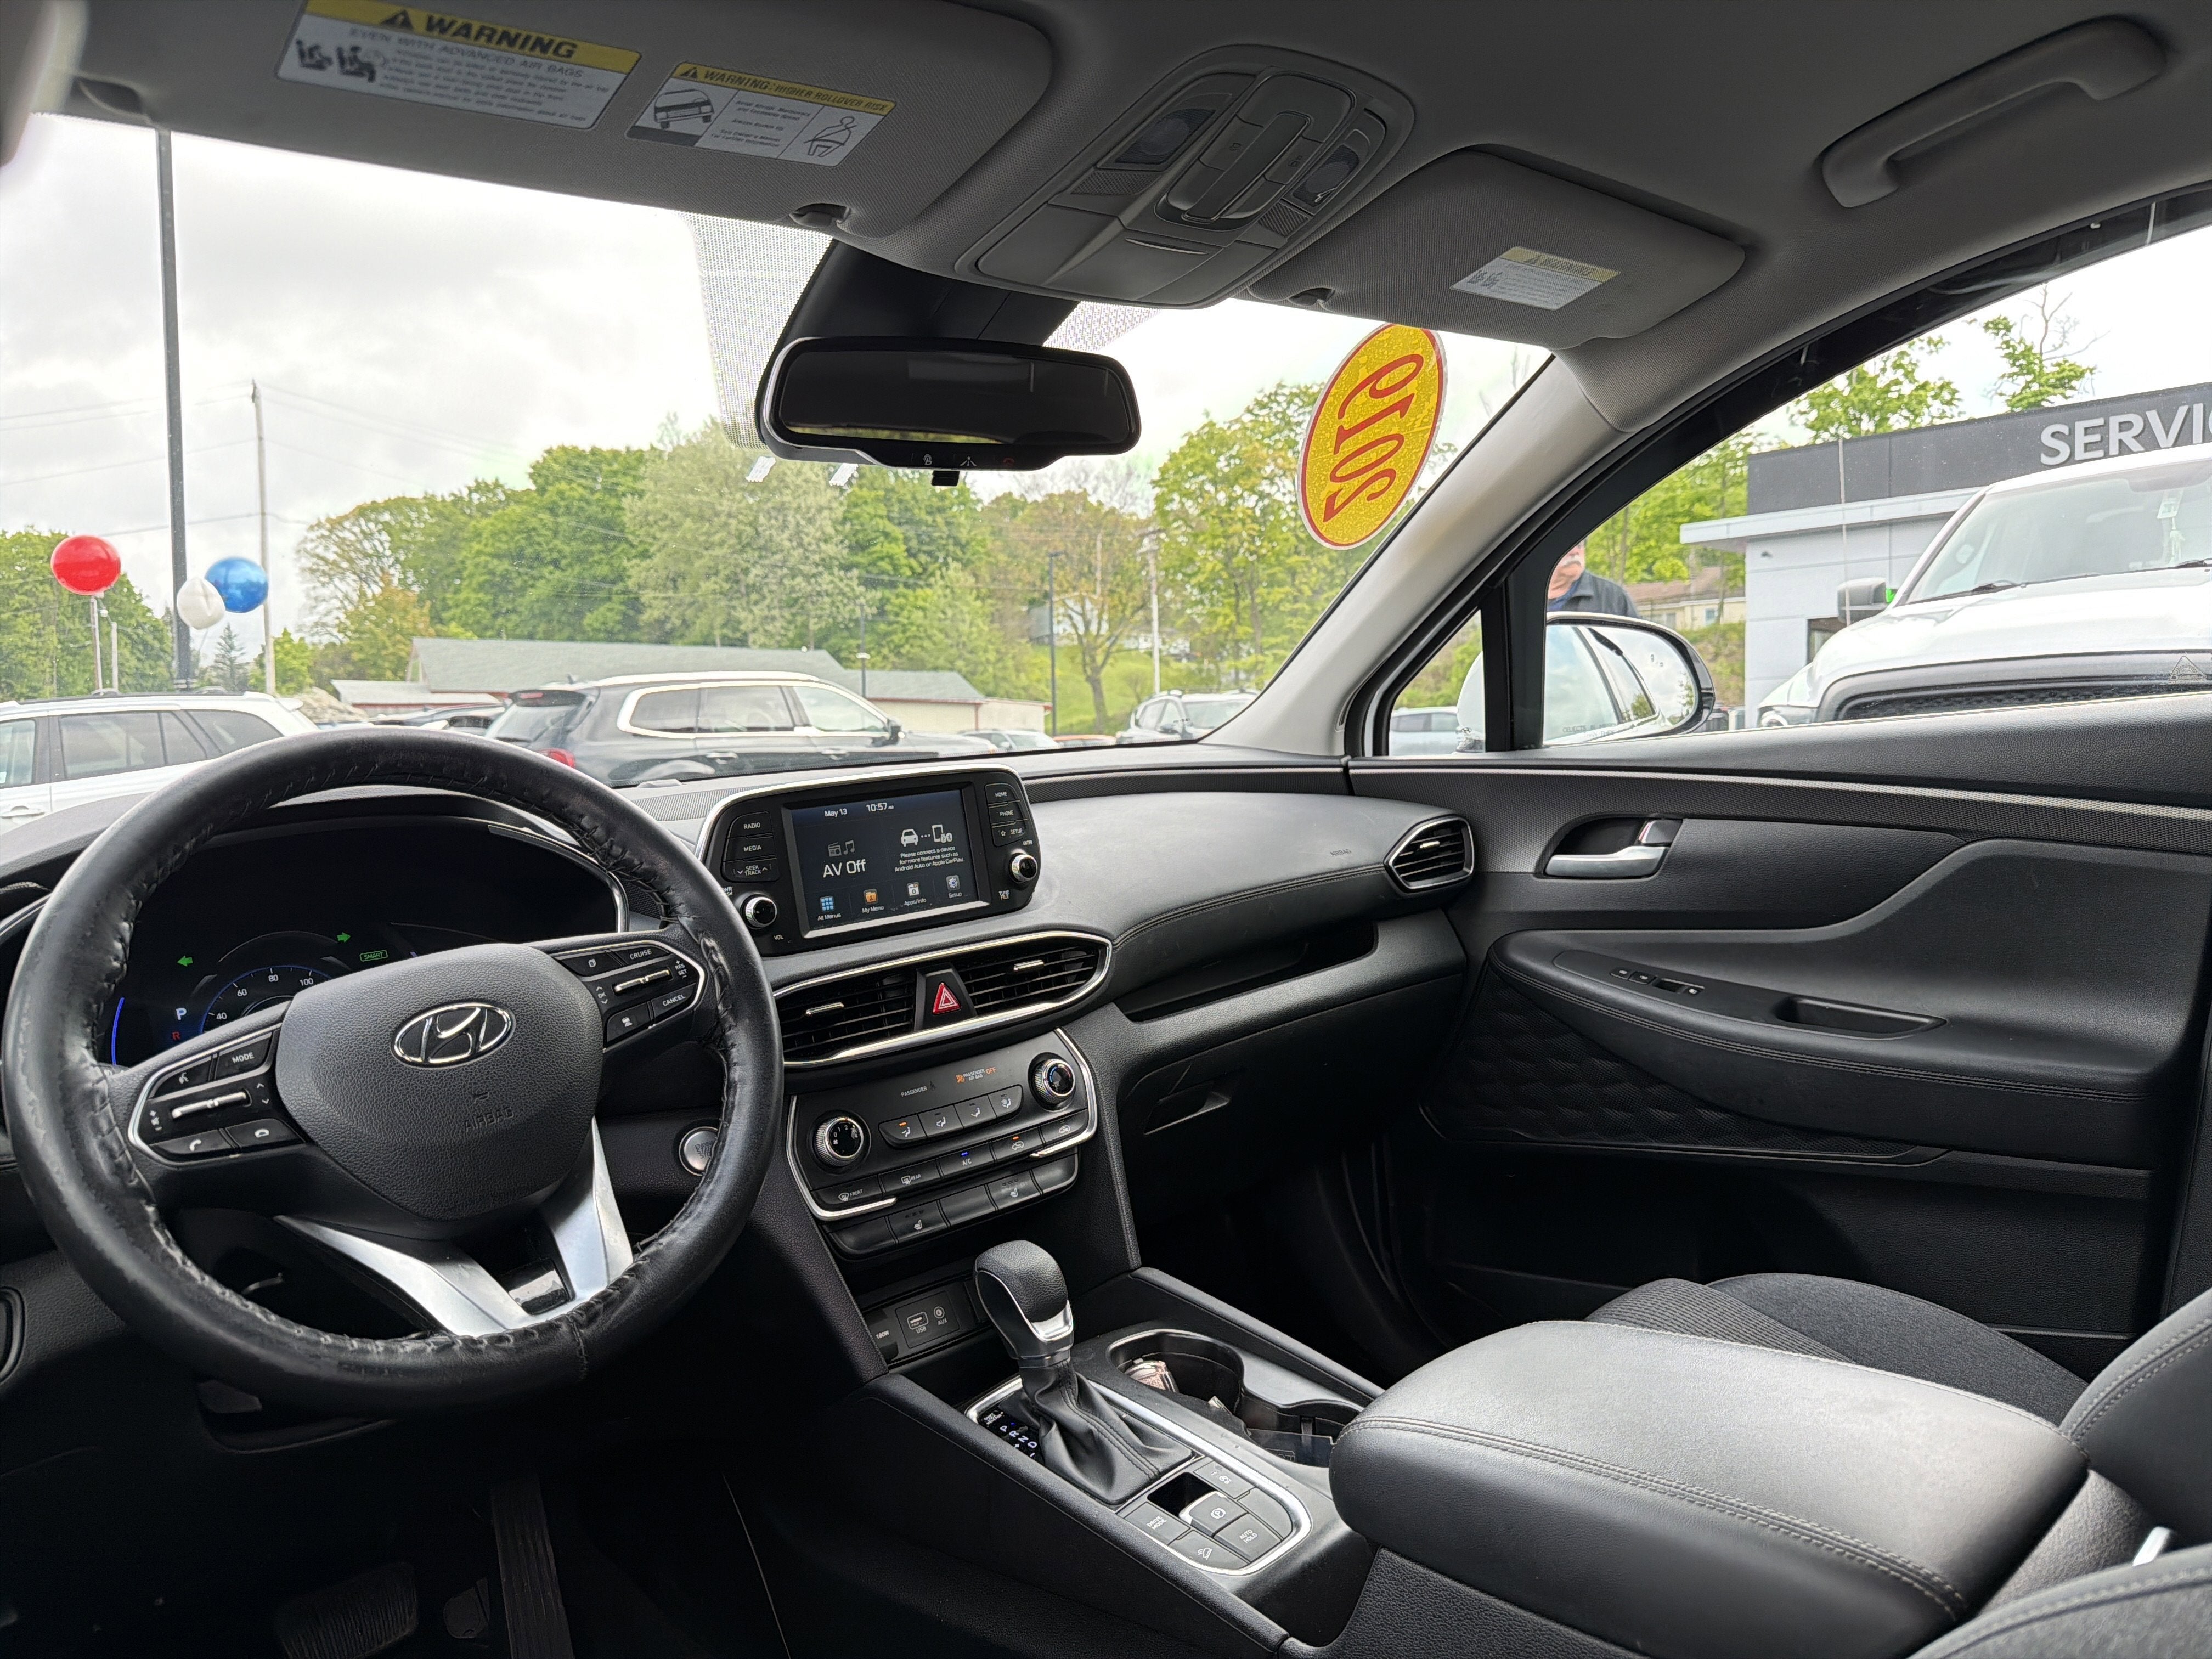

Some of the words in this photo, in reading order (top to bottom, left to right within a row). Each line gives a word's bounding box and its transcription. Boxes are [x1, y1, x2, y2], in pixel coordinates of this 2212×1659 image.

[425, 14, 578, 59] WARNING
[439, 46, 515, 65] ADVANCED
[520, 60, 542, 70] AIR
[546, 65, 583, 78] BAGS
[776, 86, 812, 97] HIGHER
[815, 92, 861, 106] ROLLOVER
[865, 102, 887, 111] RISK
[2040, 403, 2212, 465] SERVI
[866, 802, 887, 812] 10:57
[824, 809, 838, 817] May
[823, 862, 842, 878] AV
[846, 859, 866, 874] Off
[629, 949, 652, 960] CRUISE
[268, 974, 279, 983] 80
[299, 978, 314, 986] 100
[236, 988, 247, 997] 60
[662, 994, 686, 1006] CANCEL
[176, 1007, 187, 1021] P
[216, 1012, 228, 1020] 40
[172, 1031, 181, 1041] R
[232, 1052, 255, 1064] MODE
[963, 1068, 985, 1077] PASSENGER
[985, 1066, 996, 1075] OFF
[901, 1086, 928, 1097] PASSENGER
[464, 1107, 515, 1133] AIRBAG
[962, 1158, 972, 1166] A/C
[938, 1317, 948, 1326] AUX
[876, 1329, 890, 1339] 180W
[1146, 1515, 1163, 1527] DRIVE
[1151, 1519, 1167, 1530] MODE
[1239, 1528, 1254, 1539] AUTO
[1243, 1532, 1258, 1543] HOLD
